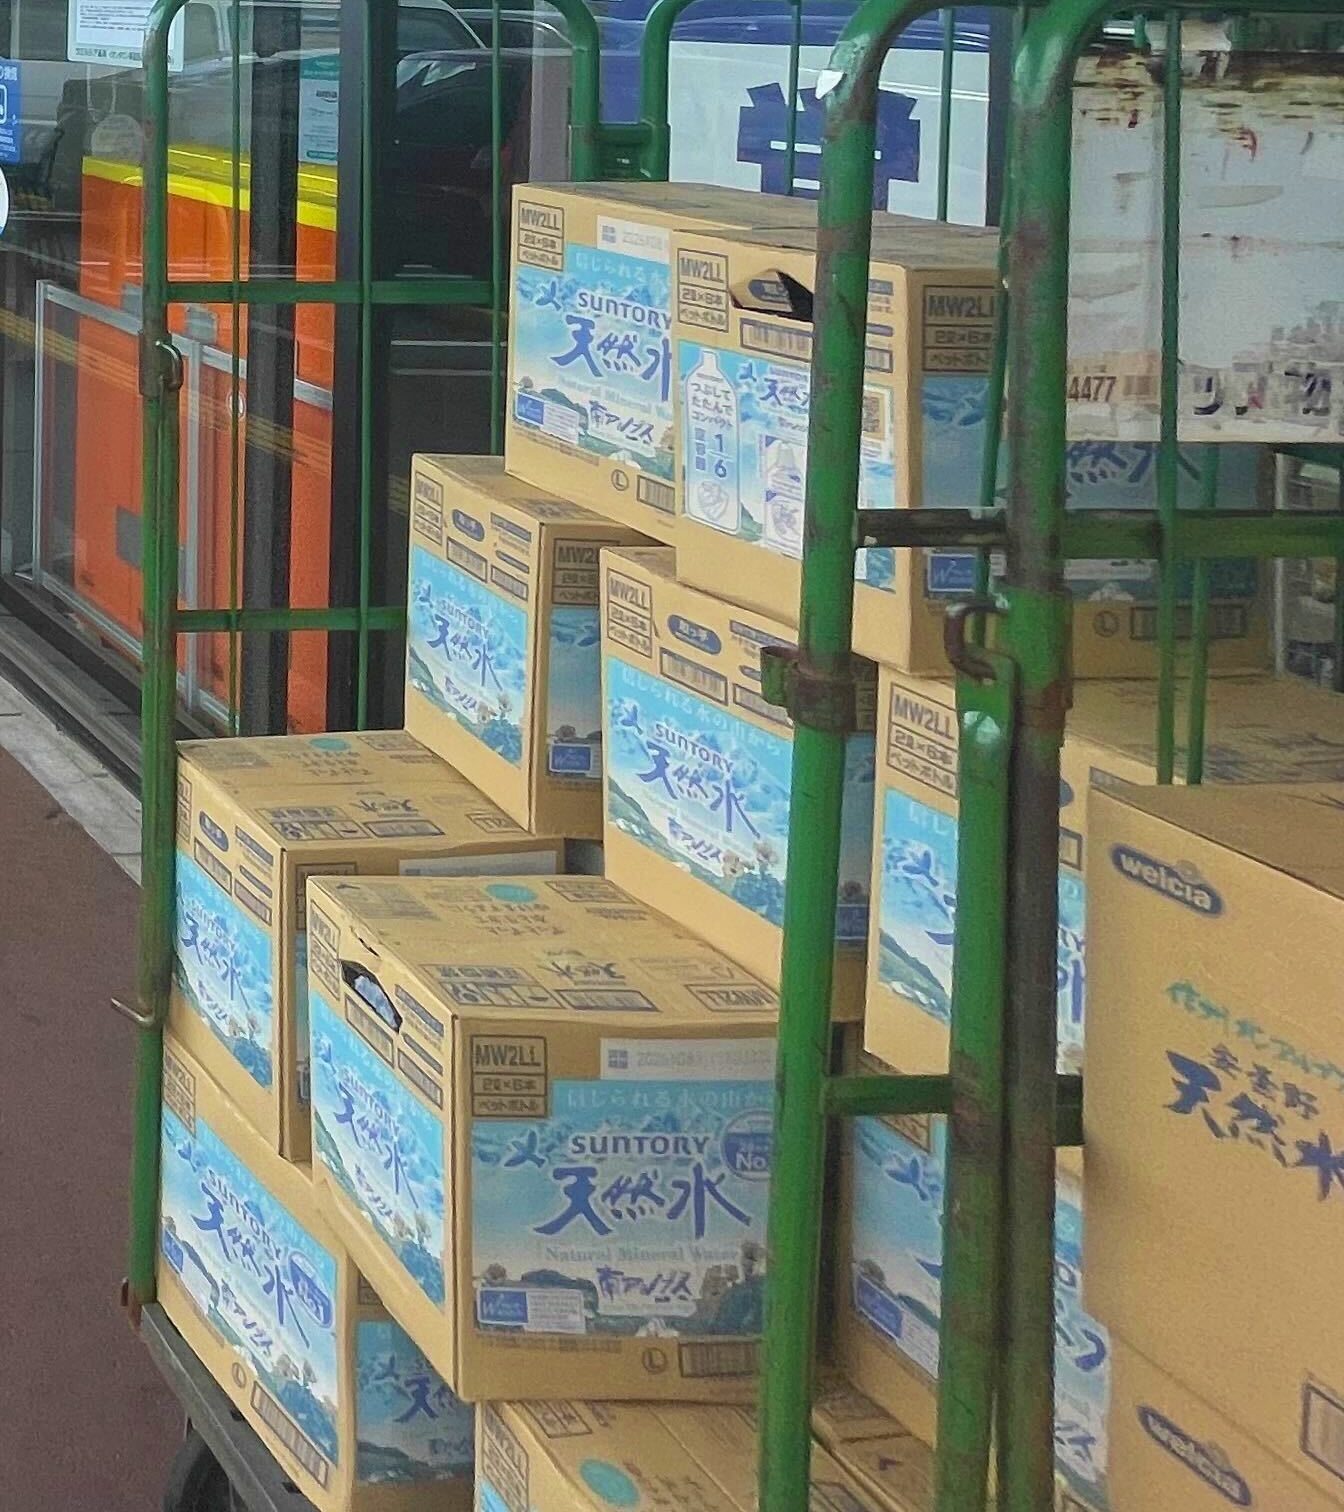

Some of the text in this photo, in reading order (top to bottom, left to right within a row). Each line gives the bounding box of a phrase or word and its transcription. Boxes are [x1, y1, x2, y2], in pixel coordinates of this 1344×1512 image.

[521, 207, 561, 231] MW2LL
[680, 256, 724, 283] MW2LL
[579, 292, 672, 331] SUNTORY
[550, 315, 672, 402] 天然水
[440, 600, 489, 637] SUNTORY
[427, 614, 502, 691] 天然水
[654, 723, 735, 776] SUNTORY
[637, 740, 761, 840] 天然水
[1119, 852, 1212, 910] welcia
[181, 911, 250, 1009] 天然水
[475, 1044, 541, 1067] MW2LL
[334, 1082, 419, 1210] 天然水
[571, 1135, 710, 1156] SUNTORY
[208, 1167, 282, 1261] SUNTORY
[534, 1161, 752, 1239] 天然水
[191, 1182, 310, 1349] 天然水
[546, 1247, 611, 1262] Natural
[619, 1246, 686, 1262] Mineral
[596, 1265, 694, 1303] 南アルプス
